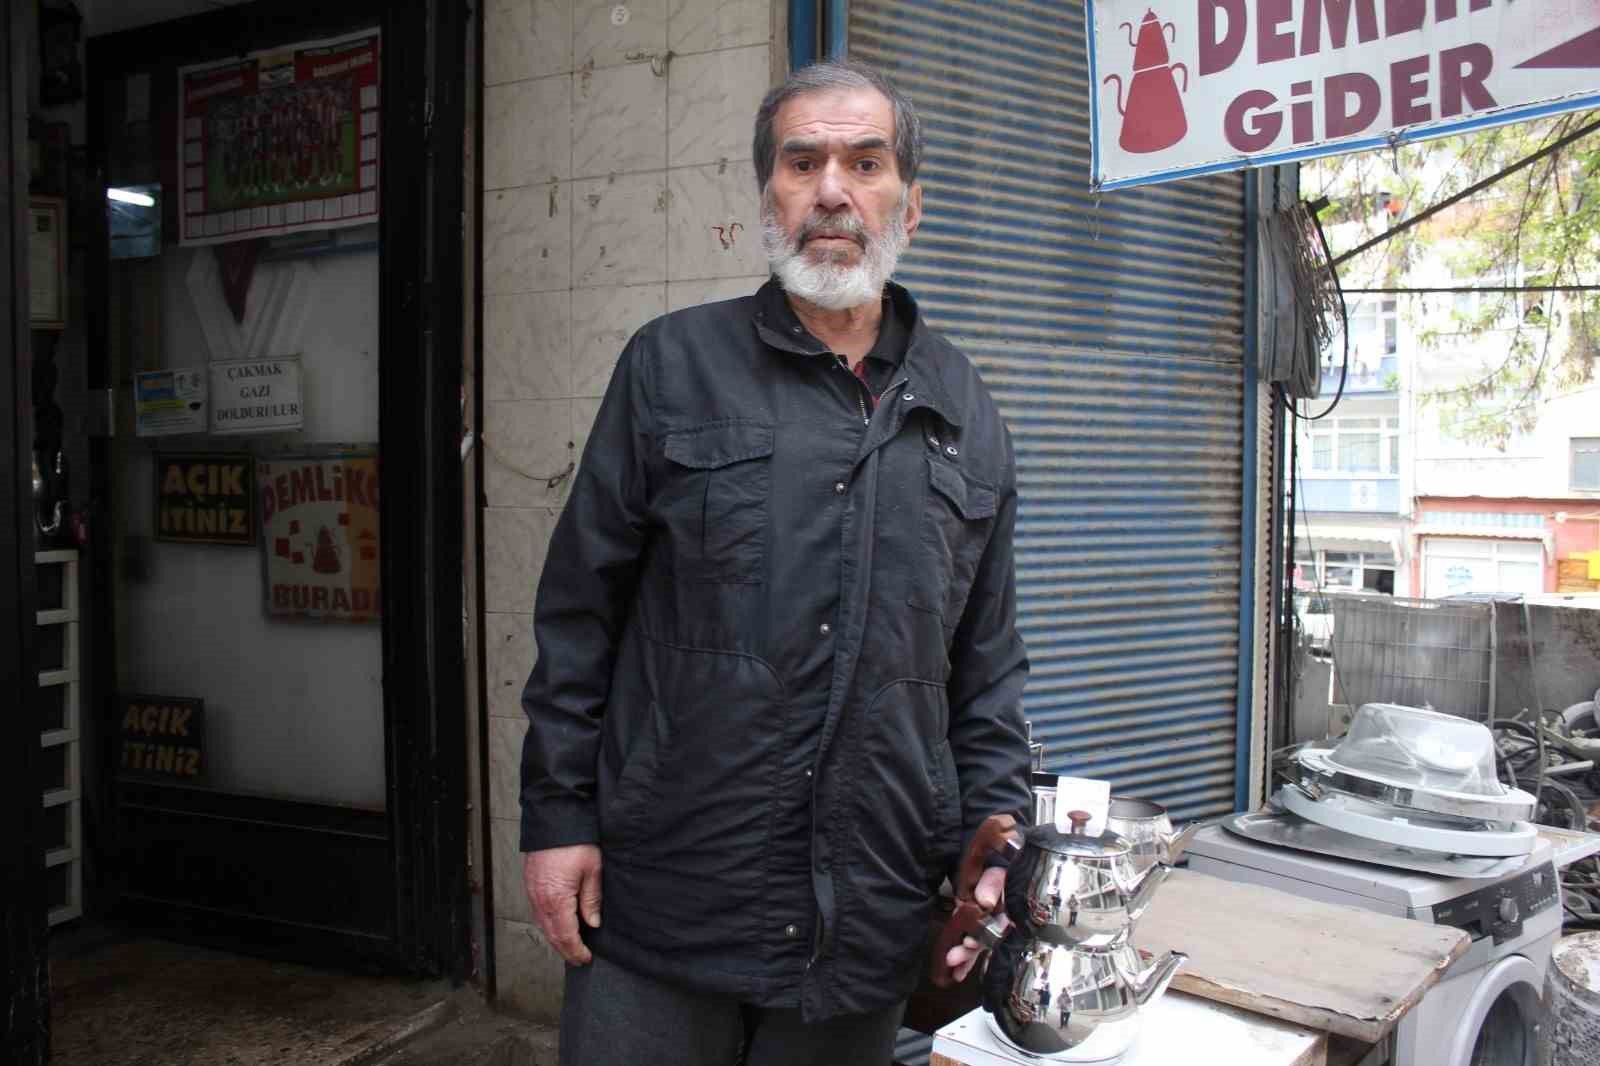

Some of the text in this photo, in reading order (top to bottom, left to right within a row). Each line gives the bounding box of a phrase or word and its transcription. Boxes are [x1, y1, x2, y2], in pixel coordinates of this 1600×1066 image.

[227, 363, 282, 383] ÇAKMAK
[216, 404, 299, 422] DOLDURULUR
[160, 464, 245, 500] AÇIK
[122, 703, 192, 737] AÇIK
